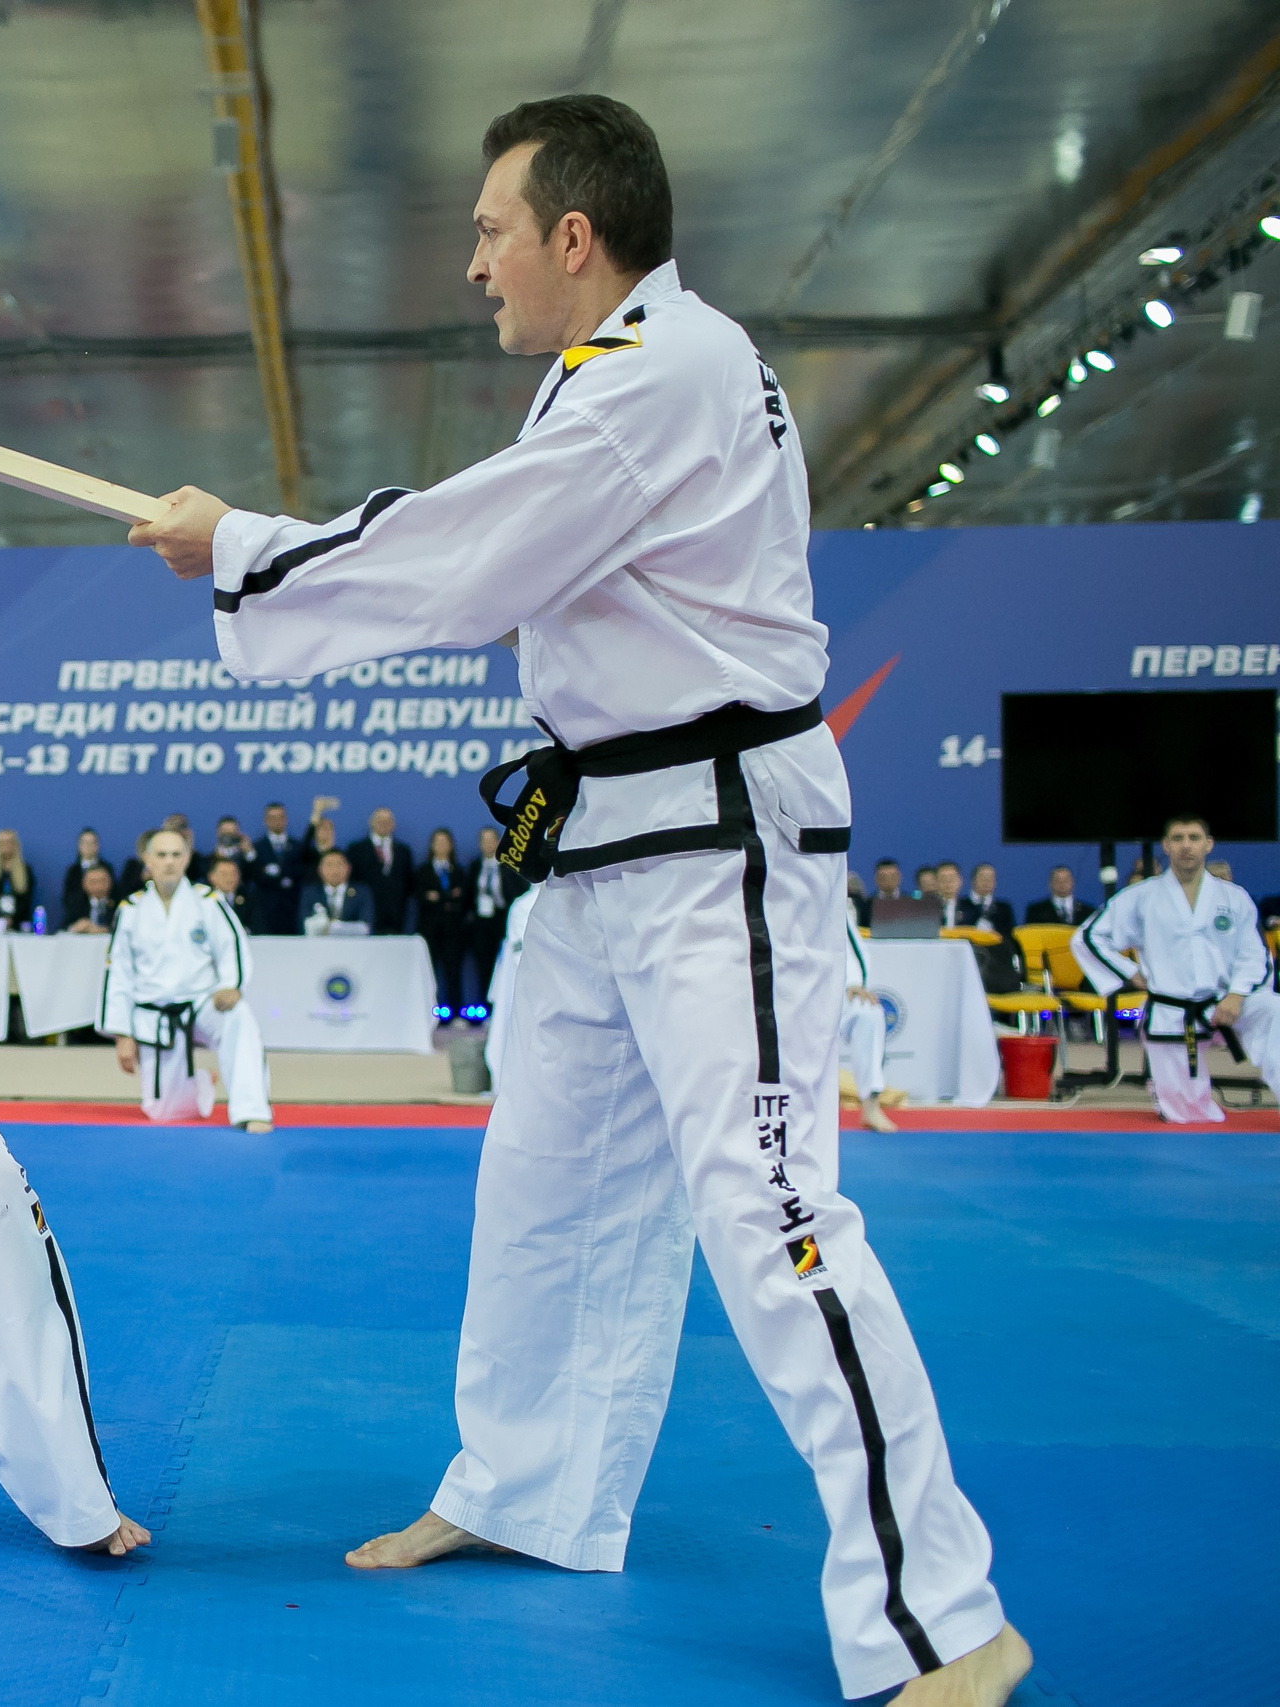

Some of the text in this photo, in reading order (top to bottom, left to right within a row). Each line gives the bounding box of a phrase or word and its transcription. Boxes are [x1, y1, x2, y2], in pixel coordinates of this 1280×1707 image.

[125, 692, 316, 732] ЮНОШЕЙ
[324, 700, 357, 730] И
[362, 697, 535, 736] ДЕВУШЕ
[77, 743, 159, 775] ЛЕТ
[164, 742, 225, 774] ПО
[234, 740, 491, 778] ТХЭКВОНДО
[499, 788, 547, 873] Fedotov
[754, 1094, 790, 1117] ITF
